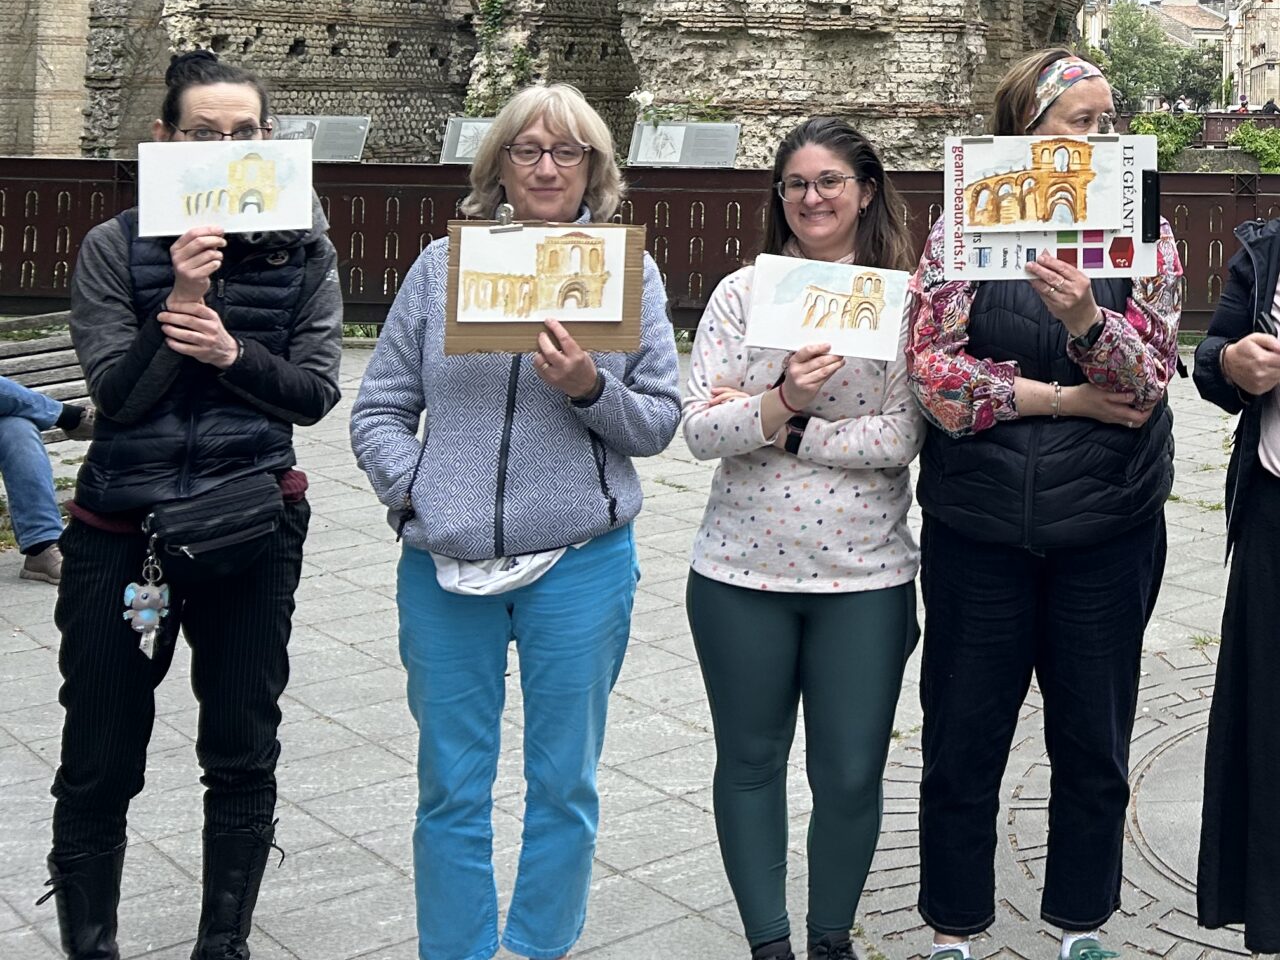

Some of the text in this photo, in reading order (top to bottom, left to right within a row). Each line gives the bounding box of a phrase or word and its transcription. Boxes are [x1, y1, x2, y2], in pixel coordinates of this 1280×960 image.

[952, 145, 965, 271] geant-beaux-arts.fr
[1123, 145, 1137, 233] LE GÉANT
